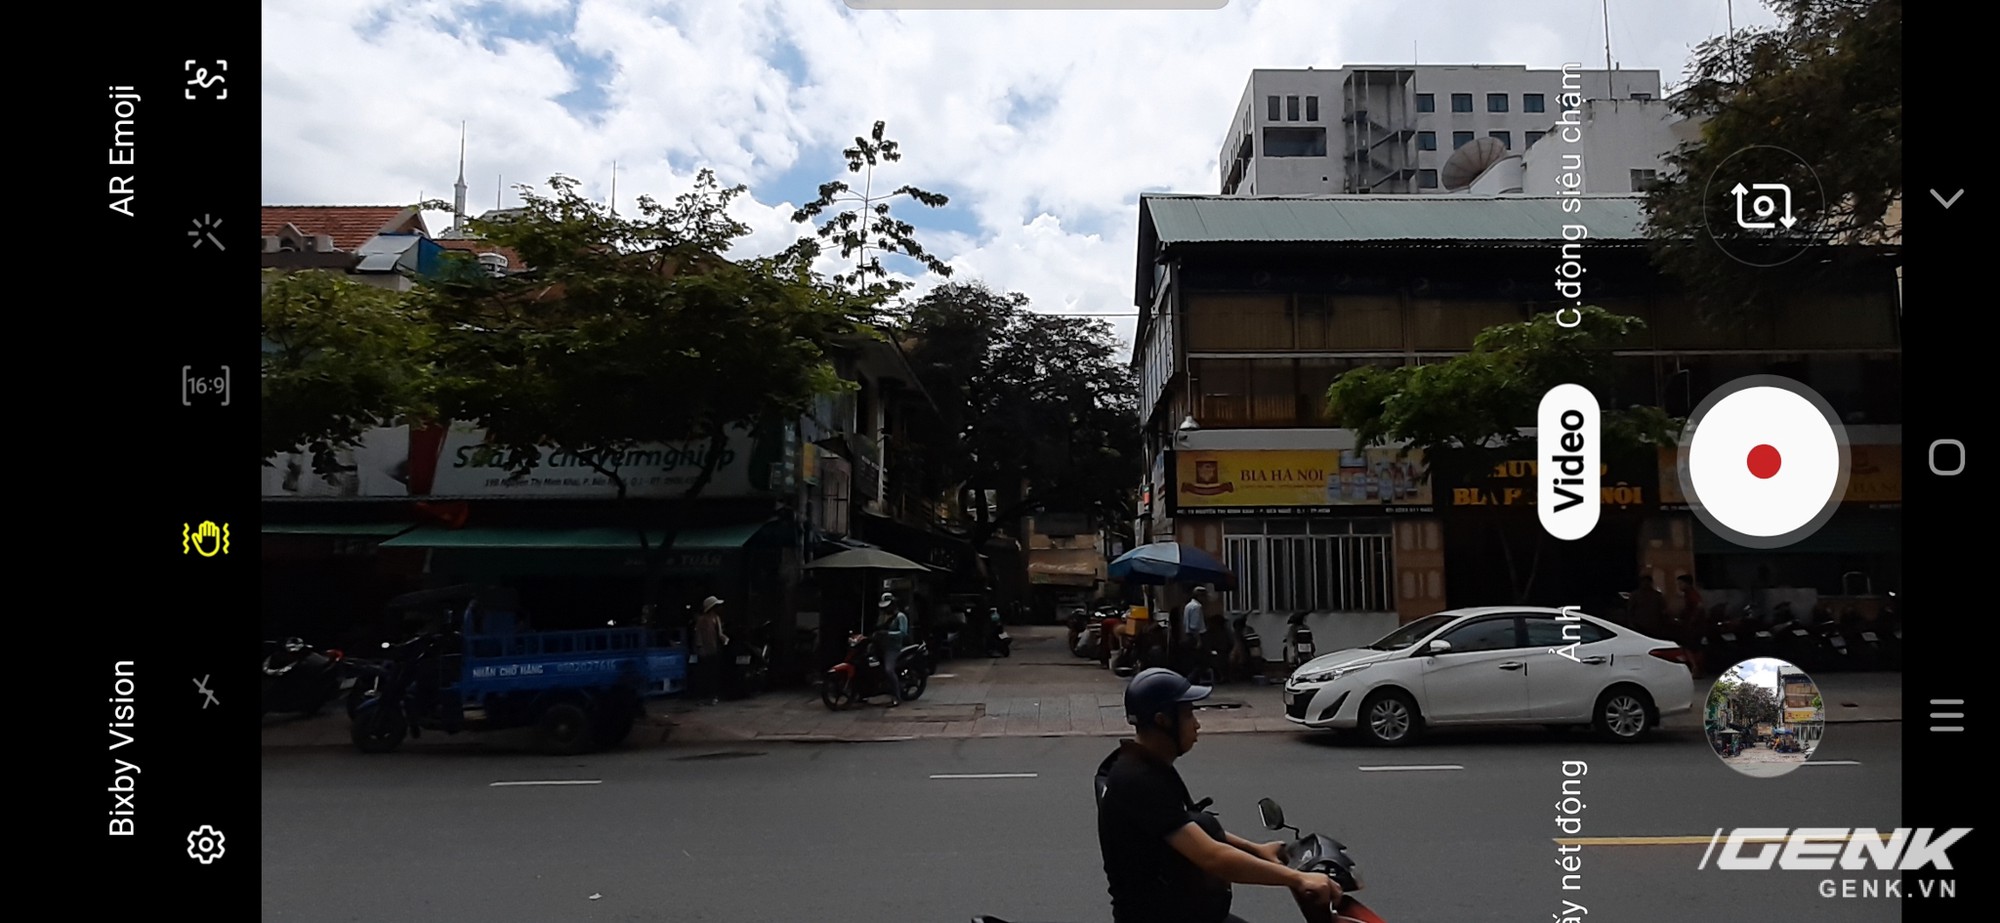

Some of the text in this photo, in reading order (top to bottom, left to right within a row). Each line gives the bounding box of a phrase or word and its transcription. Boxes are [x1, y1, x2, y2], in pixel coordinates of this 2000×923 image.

[108, 85, 142, 217] AR Emoji
[1554, 62, 1588, 327] C.động siêu chậm
[187, 376, 225, 396] 16:9
[1240, 469, 1267, 482] BIA
[1551, 409, 1585, 514] Video
[1547, 604, 1582, 664] Ảnh
[107, 660, 142, 837] Bixby Vision
[1554, 760, 1588, 834] động
[1554, 843, 1582, 891] nét
